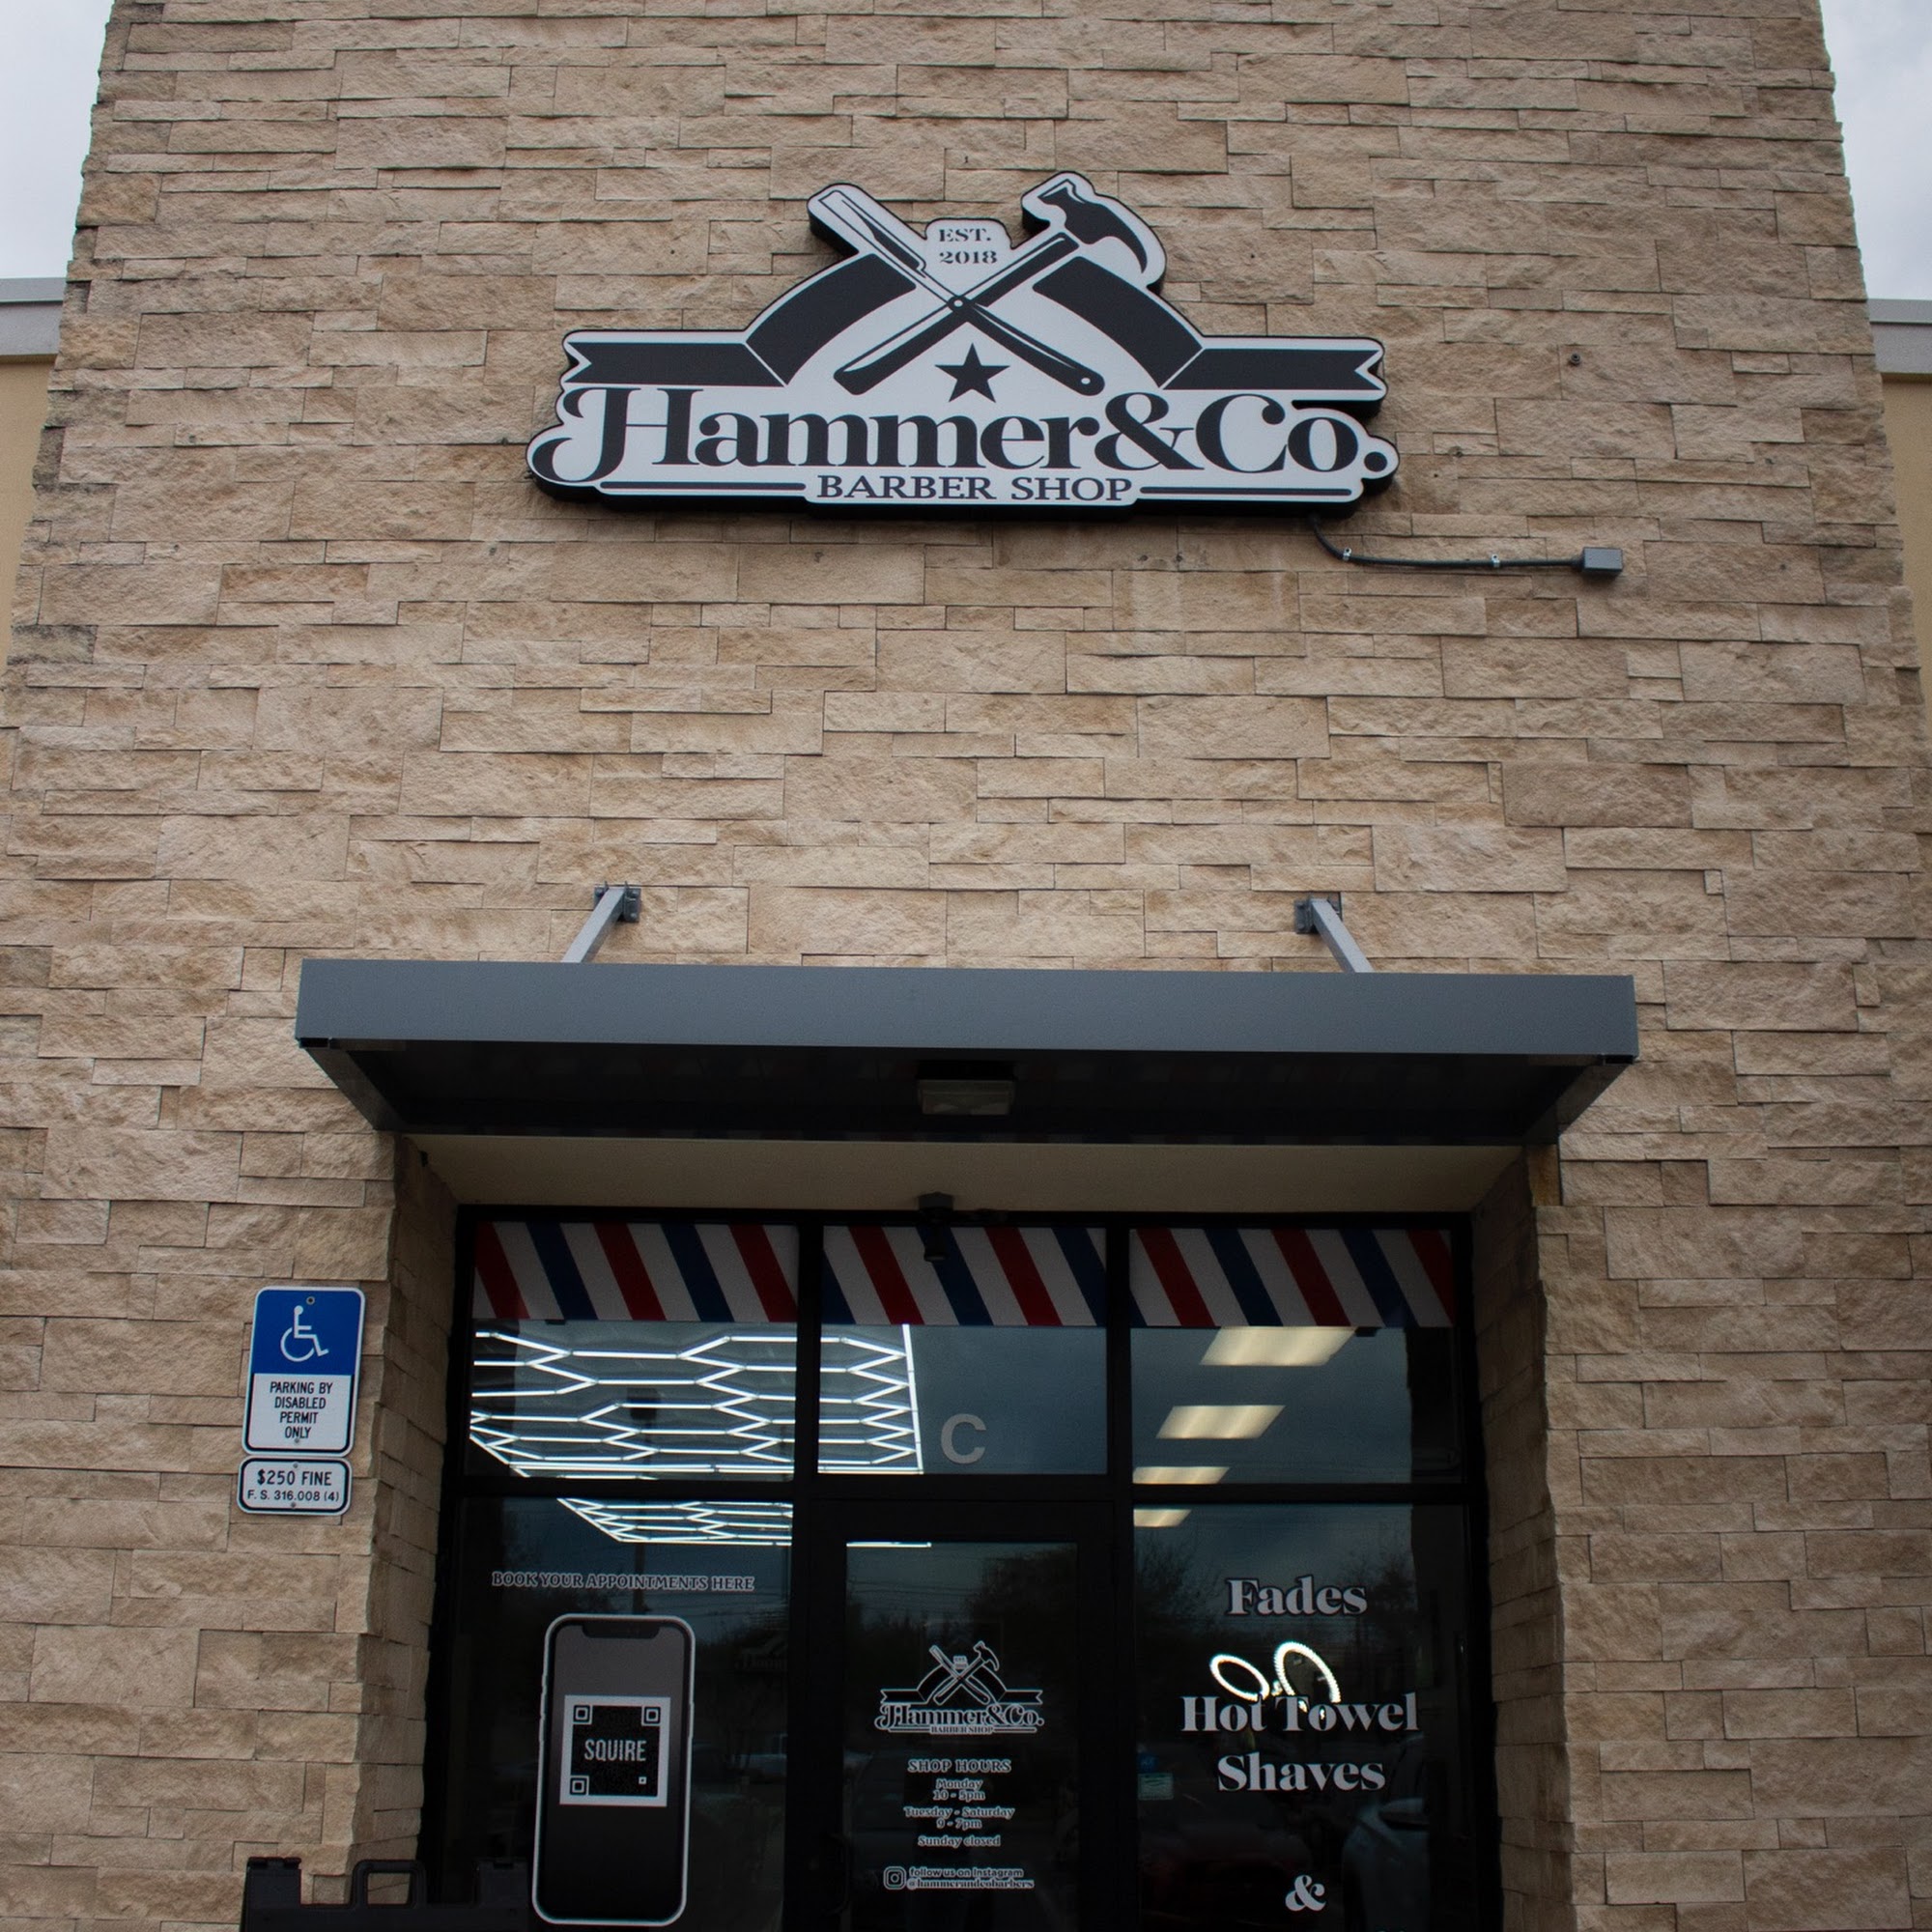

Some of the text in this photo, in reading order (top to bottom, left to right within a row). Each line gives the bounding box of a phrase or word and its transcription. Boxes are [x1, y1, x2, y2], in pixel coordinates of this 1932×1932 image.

[939, 228, 992, 242] EST.
[939, 250, 997, 265] 2018
[531, 386, 1389, 482] Hammer&Co.
[817, 474, 1134, 502] BARBER SHOP
[270, 1381, 333, 1395] PARKING BY
[274, 1396, 327, 1409] DISABLED
[279, 1411, 319, 1424] PERMIT
[284, 1426, 312, 1439] ONLY
[940, 1413, 987, 1464] C
[257, 1468, 333, 1487] $250 FINE
[273, 1490, 321, 1501] 316.008
[324, 1491, 340, 1502] (4)
[492, 1572, 755, 1592] BOOK YOUR APPOINTMENTS HERE
[1227, 1575, 1368, 1615] Fades
[1180, 1691, 1420, 1732] Hot Towel
[930, 1724, 994, 1735] BARBER SHOP
[583, 1739, 647, 1762] SQUIRE
[907, 1758, 1012, 1774] SHOP HOURS
[1217, 1751, 1386, 1792] Shaves
[935, 1777, 983, 1790] Monday
[932, 1789, 949, 1801] 10
[958, 1789, 986, 1803] 5pm
[903, 1805, 952, 1820] Tuesday
[961, 1805, 1016, 1820] Saturday
[936, 1818, 946, 1830] 9
[954, 1818, 982, 1831] 7pm
[918, 1834, 1002, 1848] Sunday closed
[909, 1866, 1024, 1879] follow us on Instagram
[1284, 1874, 1326, 1913] &
